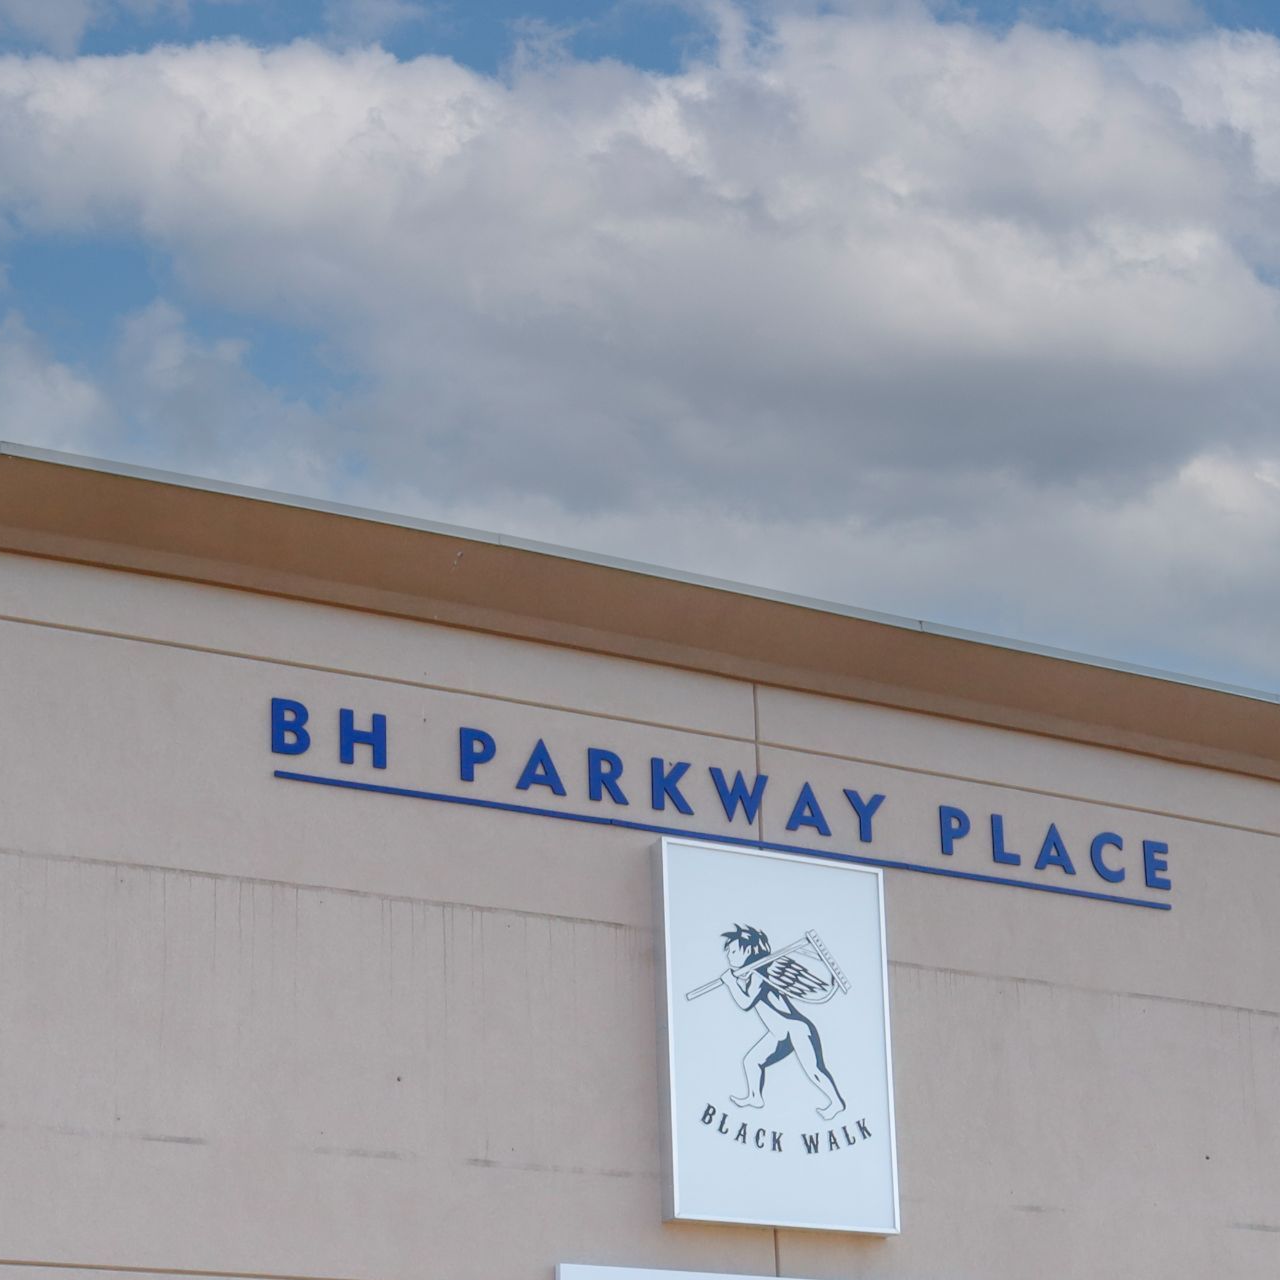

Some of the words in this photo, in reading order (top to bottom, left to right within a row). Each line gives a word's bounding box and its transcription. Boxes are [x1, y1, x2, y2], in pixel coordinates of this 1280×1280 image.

[271, 697, 387, 769] BH
[459, 728, 887, 844] PARKWAY
[939, 805, 1173, 891] PLACE
[700, 1103, 783, 1152] BLACK
[801, 1118, 872, 1154] WALK
